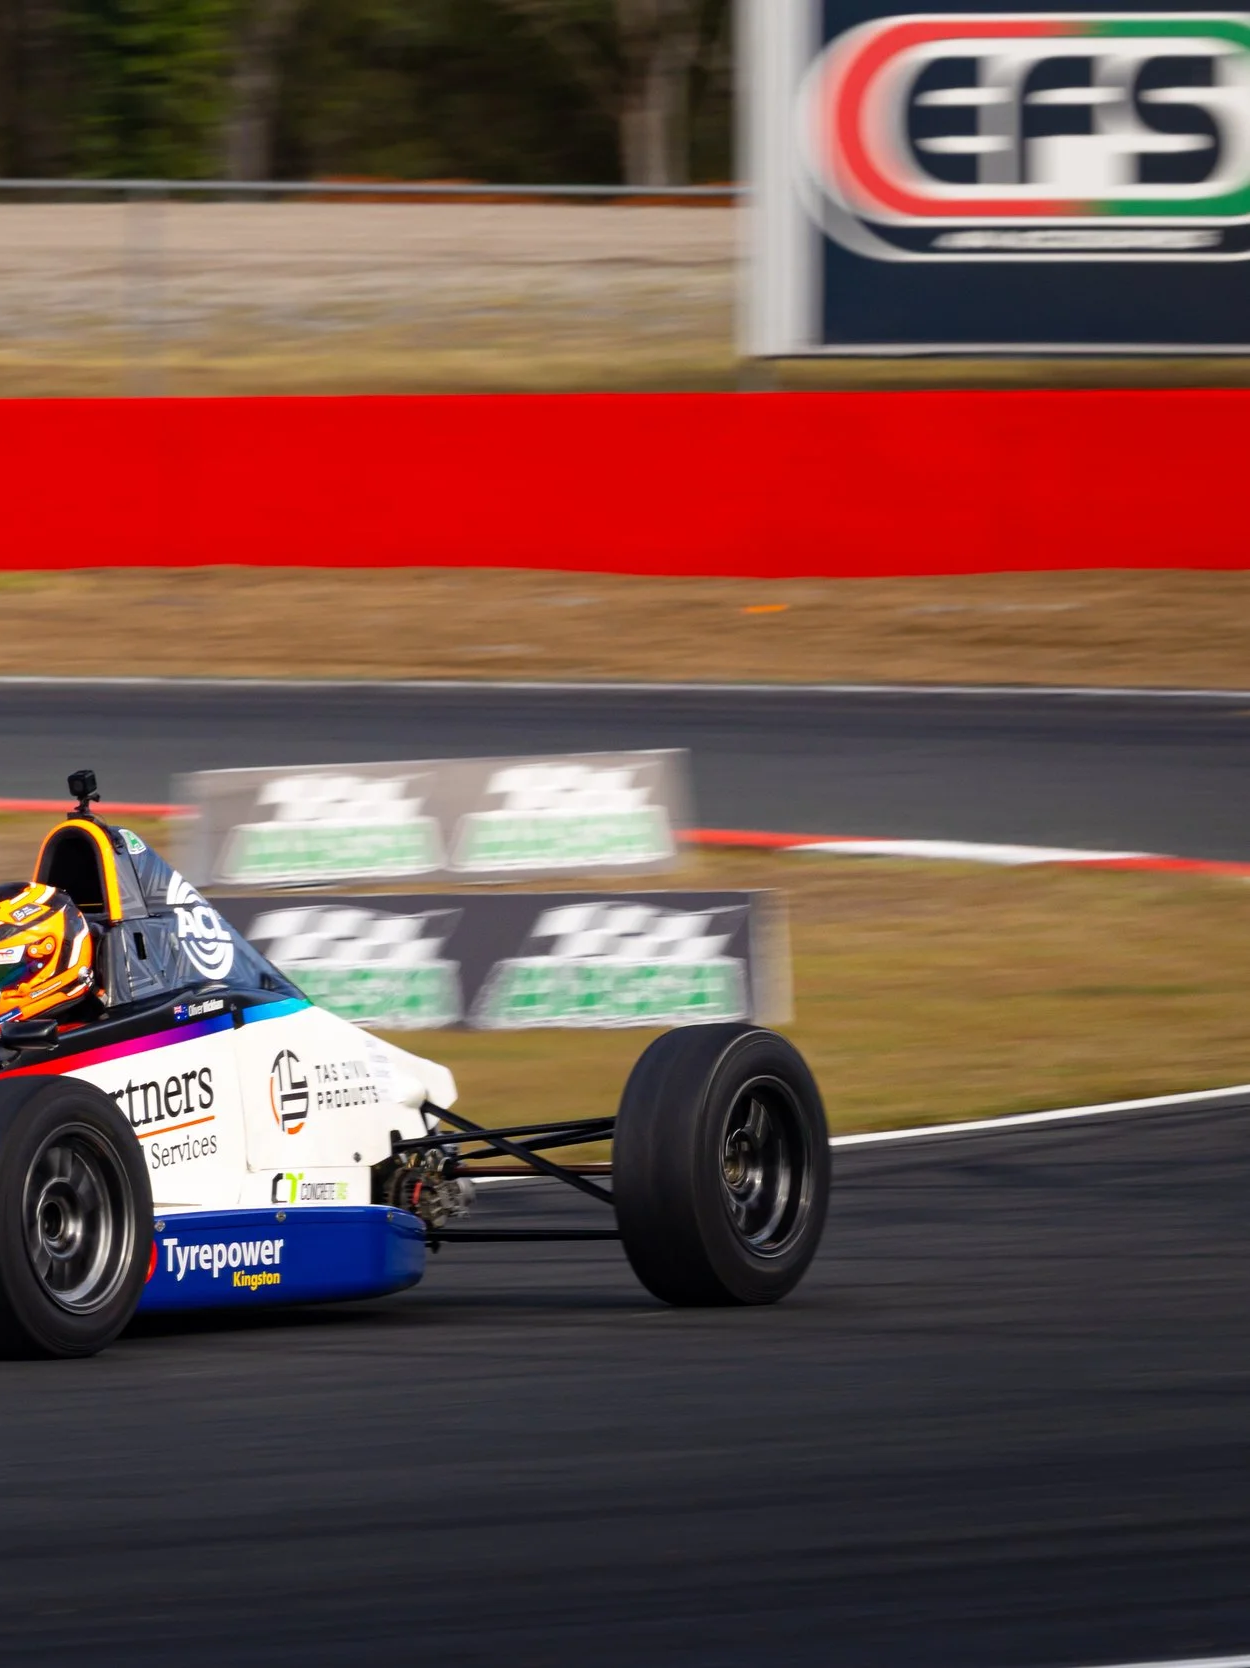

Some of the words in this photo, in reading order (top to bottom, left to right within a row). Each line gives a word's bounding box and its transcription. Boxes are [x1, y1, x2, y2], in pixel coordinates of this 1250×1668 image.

[173, 905, 232, 941] ACL
[151, 1134, 217, 1169] Services
[162, 1237, 284, 1282] Tyrepower
[232, 1270, 281, 1292] Kingston
